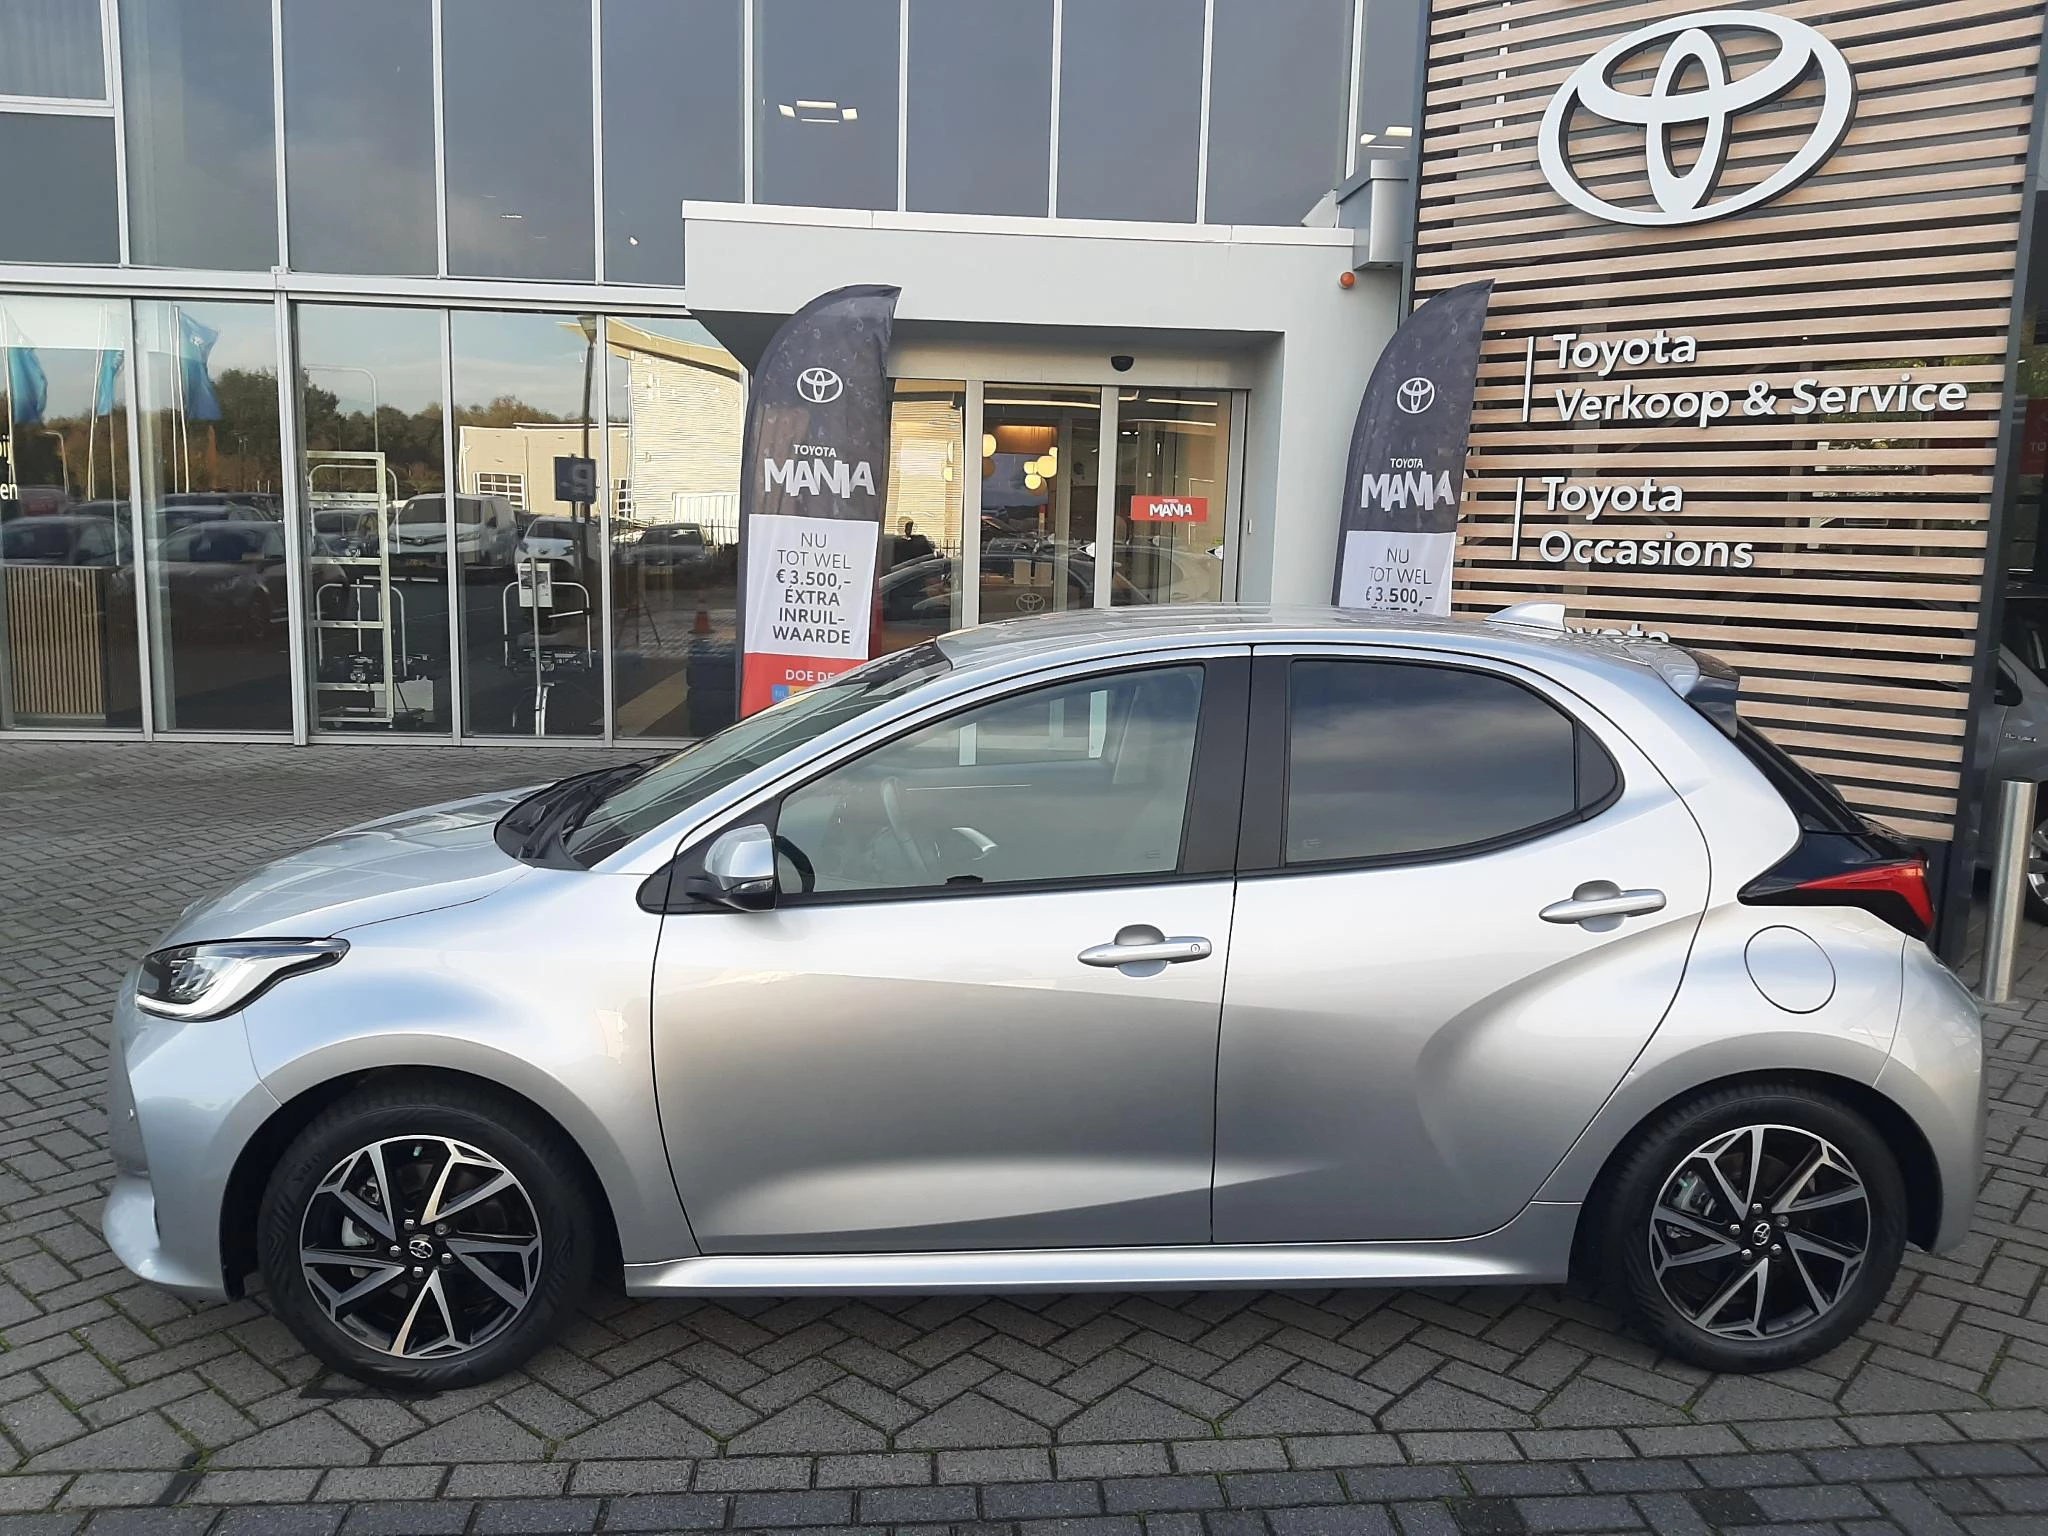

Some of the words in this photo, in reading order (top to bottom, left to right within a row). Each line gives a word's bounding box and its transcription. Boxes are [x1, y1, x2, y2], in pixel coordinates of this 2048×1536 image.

[1552, 330, 1698, 377] Toyota
[1556, 385, 1731, 428] Verkoop
[1742, 380, 1777, 416] &
[1791, 373, 1968, 415] Service
[793, 444, 837, 458] TOYOTA
[1390, 458, 1424, 469] TOYOTA
[764, 458, 876, 499] MANIA
[1361, 470, 1455, 512] MANIA
[1541, 476, 1684, 520] Toyota
[1149, 503, 1193, 518] MANIA
[801, 532, 827, 549] NU
[1539, 531, 1755, 568] Occasions
[777, 549, 809, 567] TOT
[814, 553, 852, 570] WEL
[1386, 547, 1410, 564] NU
[1369, 566, 1393, 582] TOT
[1397, 568, 1433, 585] WEL
[785, 585, 840, 607] ÉXTRA
[779, 607, 846, 625] INRUIL-
[772, 625, 851, 645] WAARDE
[785, 669, 814, 682] DOE
